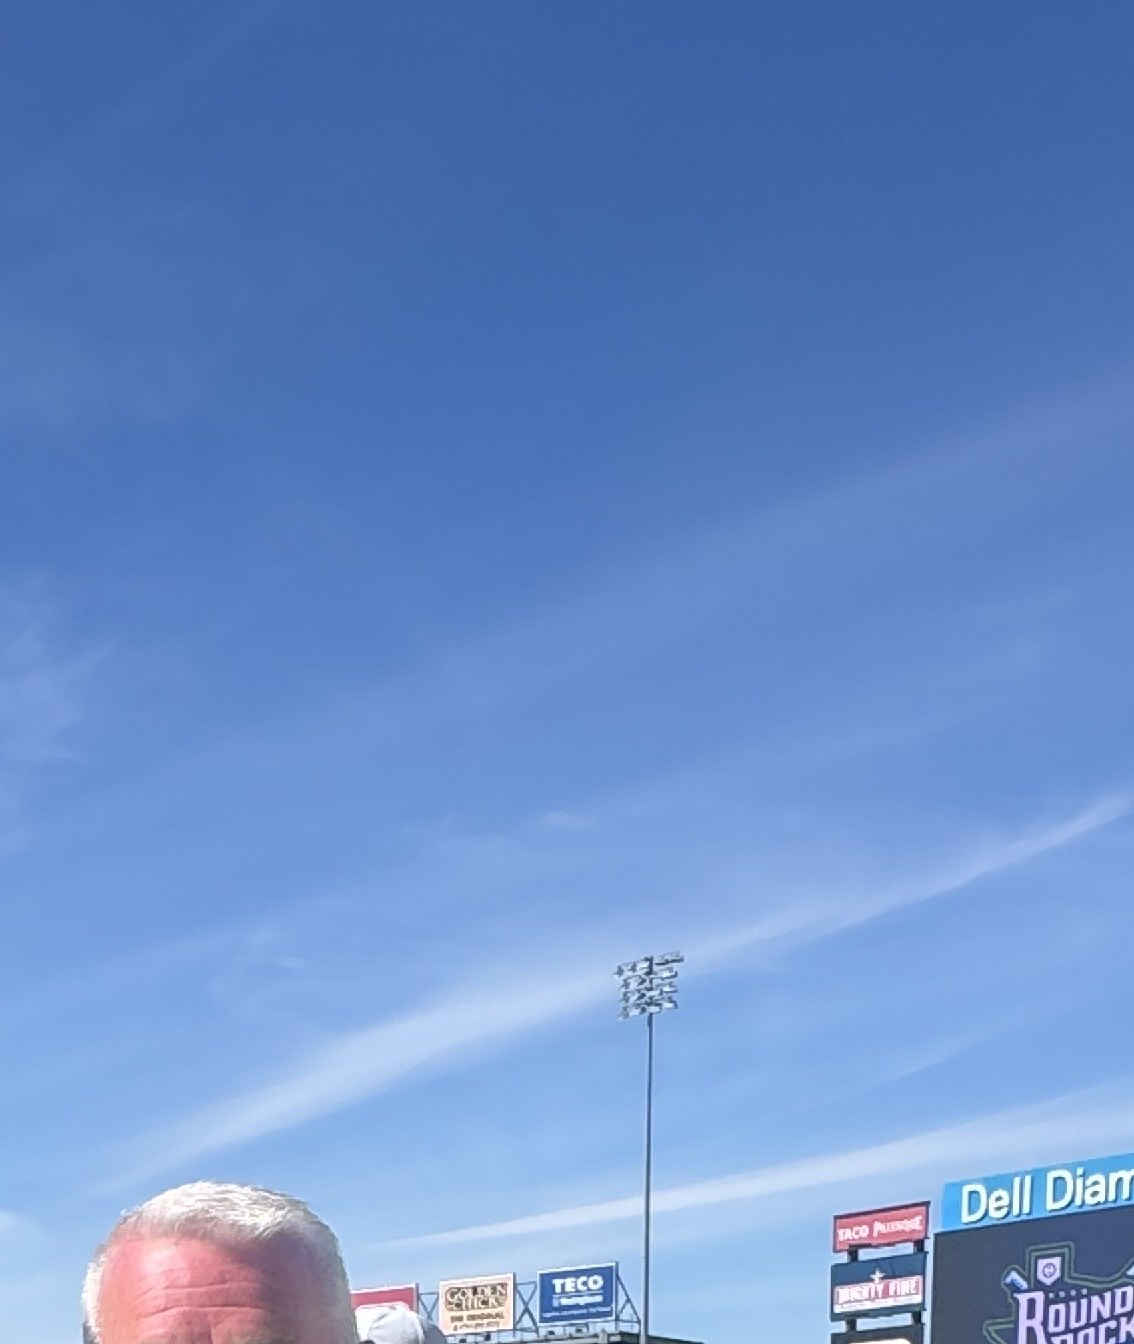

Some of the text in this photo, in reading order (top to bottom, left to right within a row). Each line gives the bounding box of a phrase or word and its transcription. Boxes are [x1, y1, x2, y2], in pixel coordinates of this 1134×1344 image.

[960, 1174, 1032, 1224] Dell
[838, 1225, 870, 1241] TACO
[552, 1275, 604, 1293] TECO
[888, 1279, 918, 1297] FINE
